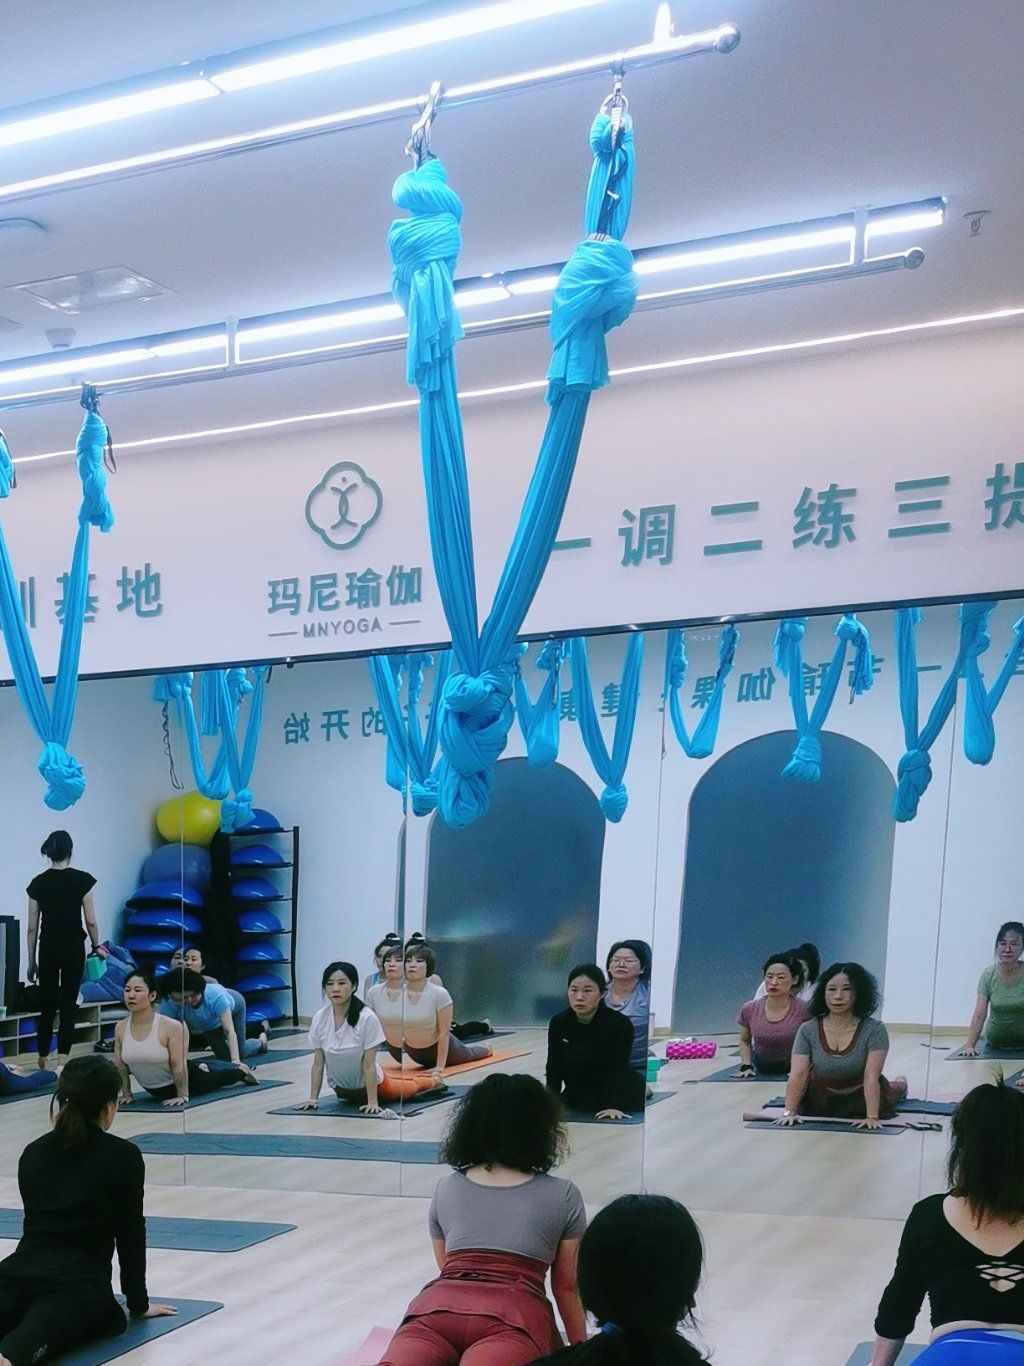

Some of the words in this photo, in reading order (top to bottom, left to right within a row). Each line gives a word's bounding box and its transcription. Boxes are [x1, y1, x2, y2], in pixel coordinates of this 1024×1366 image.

[267, 564, 423, 616] 玛尼瑜伽
[303, 617, 383, 638] MNYOGA
